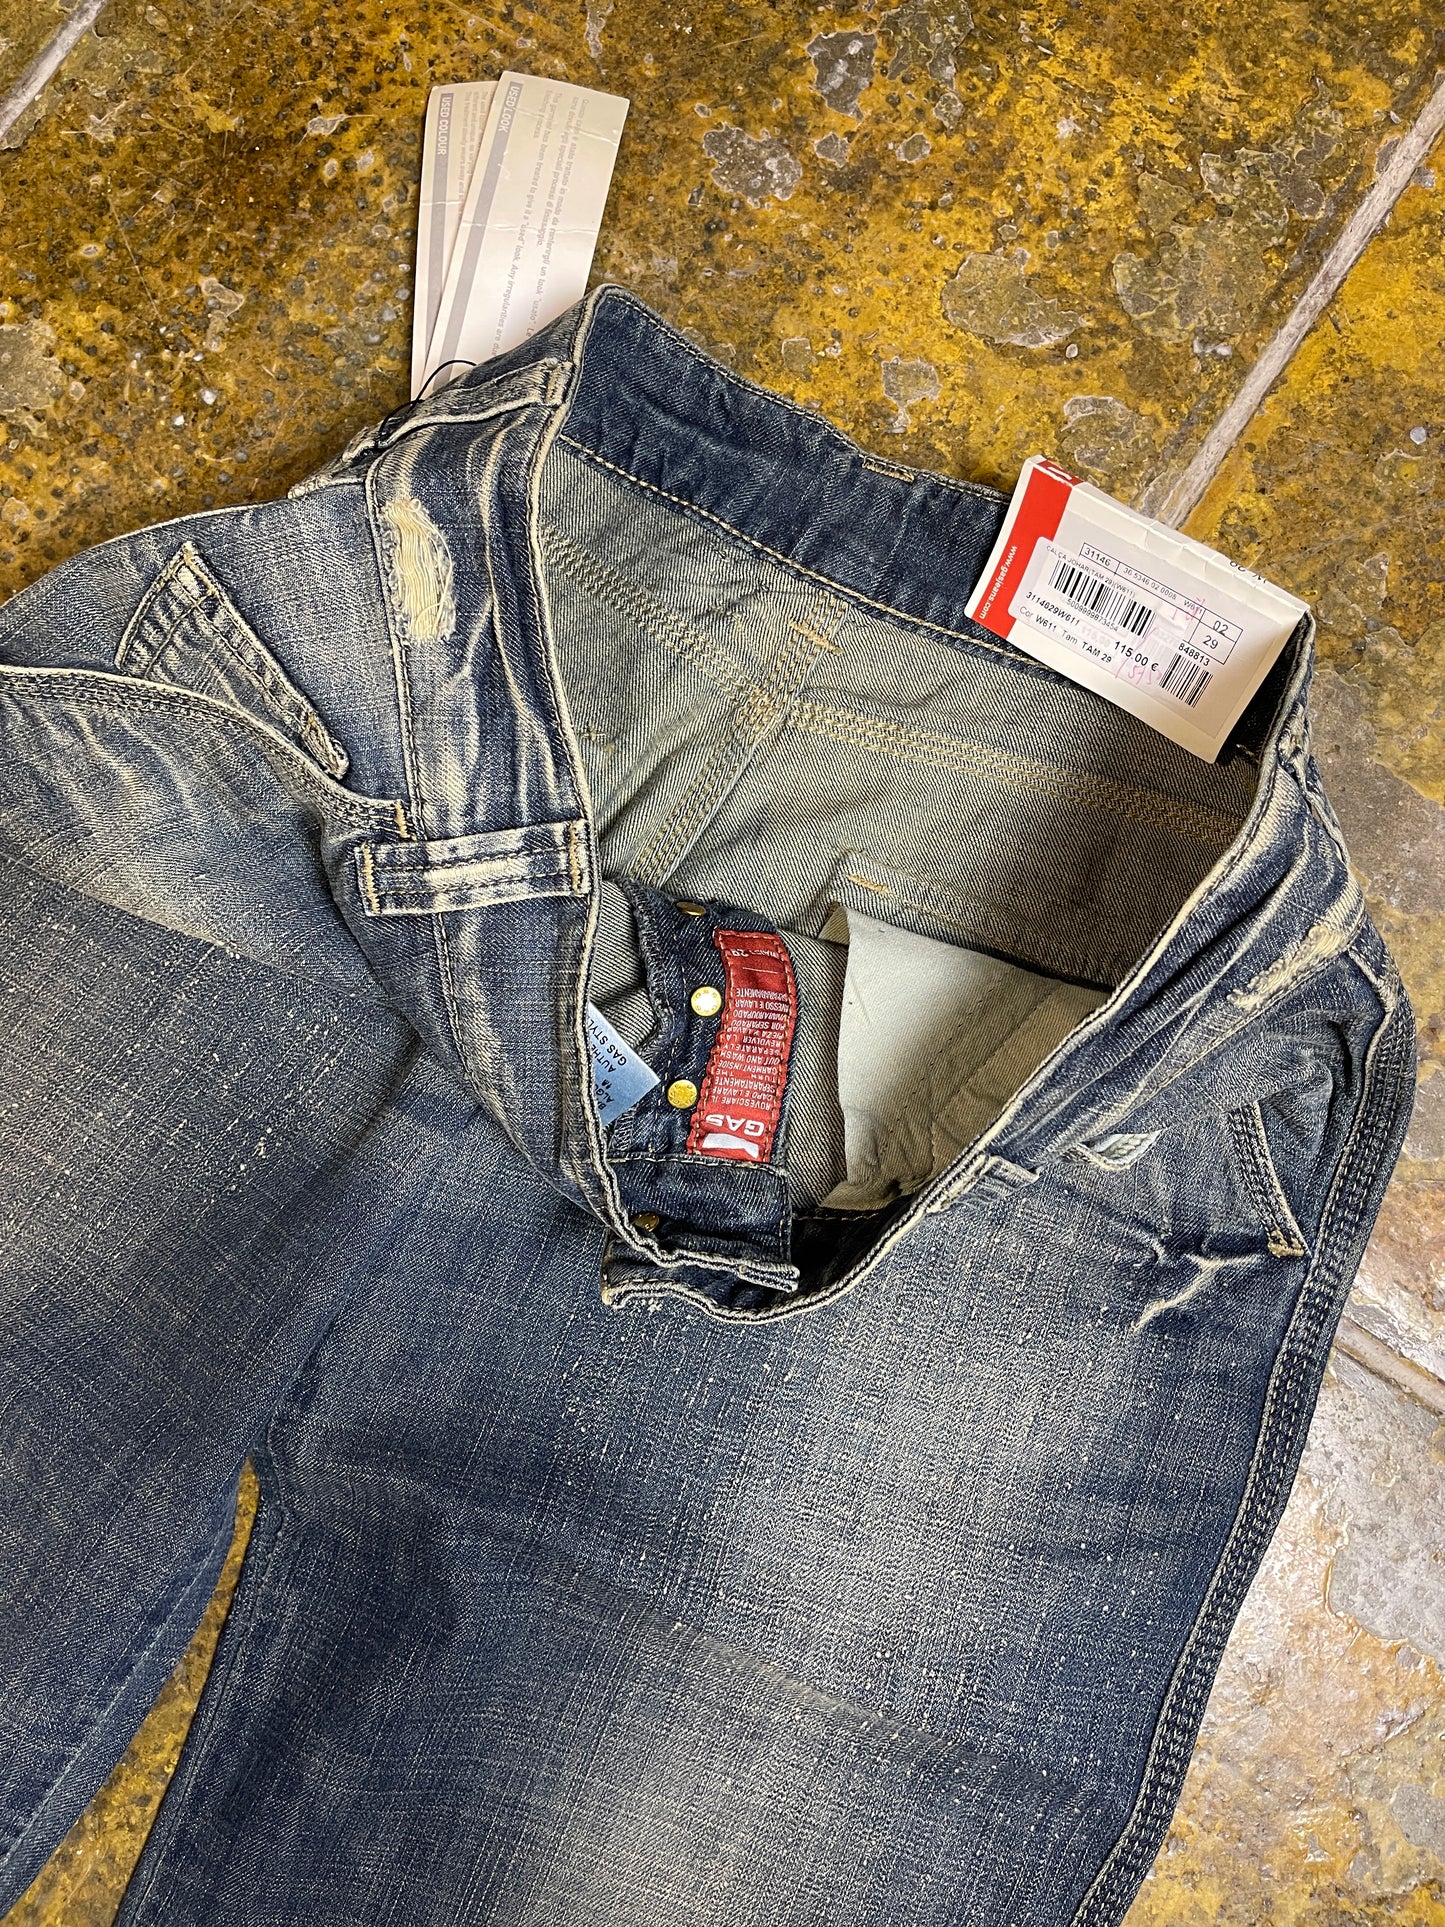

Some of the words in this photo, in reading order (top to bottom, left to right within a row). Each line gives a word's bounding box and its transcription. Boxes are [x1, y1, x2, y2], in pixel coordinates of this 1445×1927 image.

[504, 85, 519, 107] USED
[440, 97, 450, 117] USED
[497, 107, 513, 133] LOOK
[437, 119, 448, 155] COLOUR
[537, 143, 548, 161] been
[567, 142, 578, 160] stato
[531, 161, 544, 186] treated
[561, 160, 574, 186] trattato
[546, 170, 560, 200] processi
[559, 187, 567, 195] in
[523, 193, 535, 208] give
[554, 195, 565, 215] modo
[551, 216, 560, 226] da
[516, 221, 529, 245] "used"
[506, 263, 519, 279] Any
[539, 265, 548, 277] un
[534, 278, 545, 295] look
[494, 279, 516, 327] irregularities
[494, 328, 503, 341] are
[1044, 544, 1068, 561] CALÇA
[1083, 547, 1112, 567] 31146
[1131, 572, 1150, 585] 5346
[1149, 581, 1160, 591] 02
[976, 544, 1020, 620] www.gasjeans.com
[1023, 591, 1081, 627] 3114629W611
[1018, 605, 1034, 619] Cor
[1033, 615, 1057, 632] W611
[1060, 629, 1079, 645] Tam
[1080, 641, 1101, 657] TAM
[1100, 653, 1112, 663] 29
[1210, 619, 1230, 636] 02
[1201, 634, 1219, 650] 29
[1111, 640, 1150, 666] 115.00
[1149, 661, 1159, 671] €
[1176, 642, 1211, 667] 848813
[734, 998, 757, 1009] LAVAR
[758, 1000, 764, 1008] E
[725, 1034, 737, 1042] LA
[742, 1035, 780, 1047] REVOLVER
[761, 1029, 784, 1039] PIEZA
[605, 1043, 628, 1067] GAS
[719, 1049, 744, 1062] WASH
[722, 1042, 779, 1056] SEPARATELY
[717, 1059, 742, 1070] INSIDE
[746, 1055, 762, 1064] AND
[764, 1055, 779, 1066] OUT
[715, 1068, 734, 1076] THE
[743, 1063, 777, 1074] GARMENT
[714, 1075, 775, 1092] SEPARATAMENTE
[710, 1095, 718, 1103] IL
[720, 1096, 770, 1110] ROVESCIARE
[751, 1091, 772, 1100] CAPO
[704, 1112, 765, 1137] GAS
